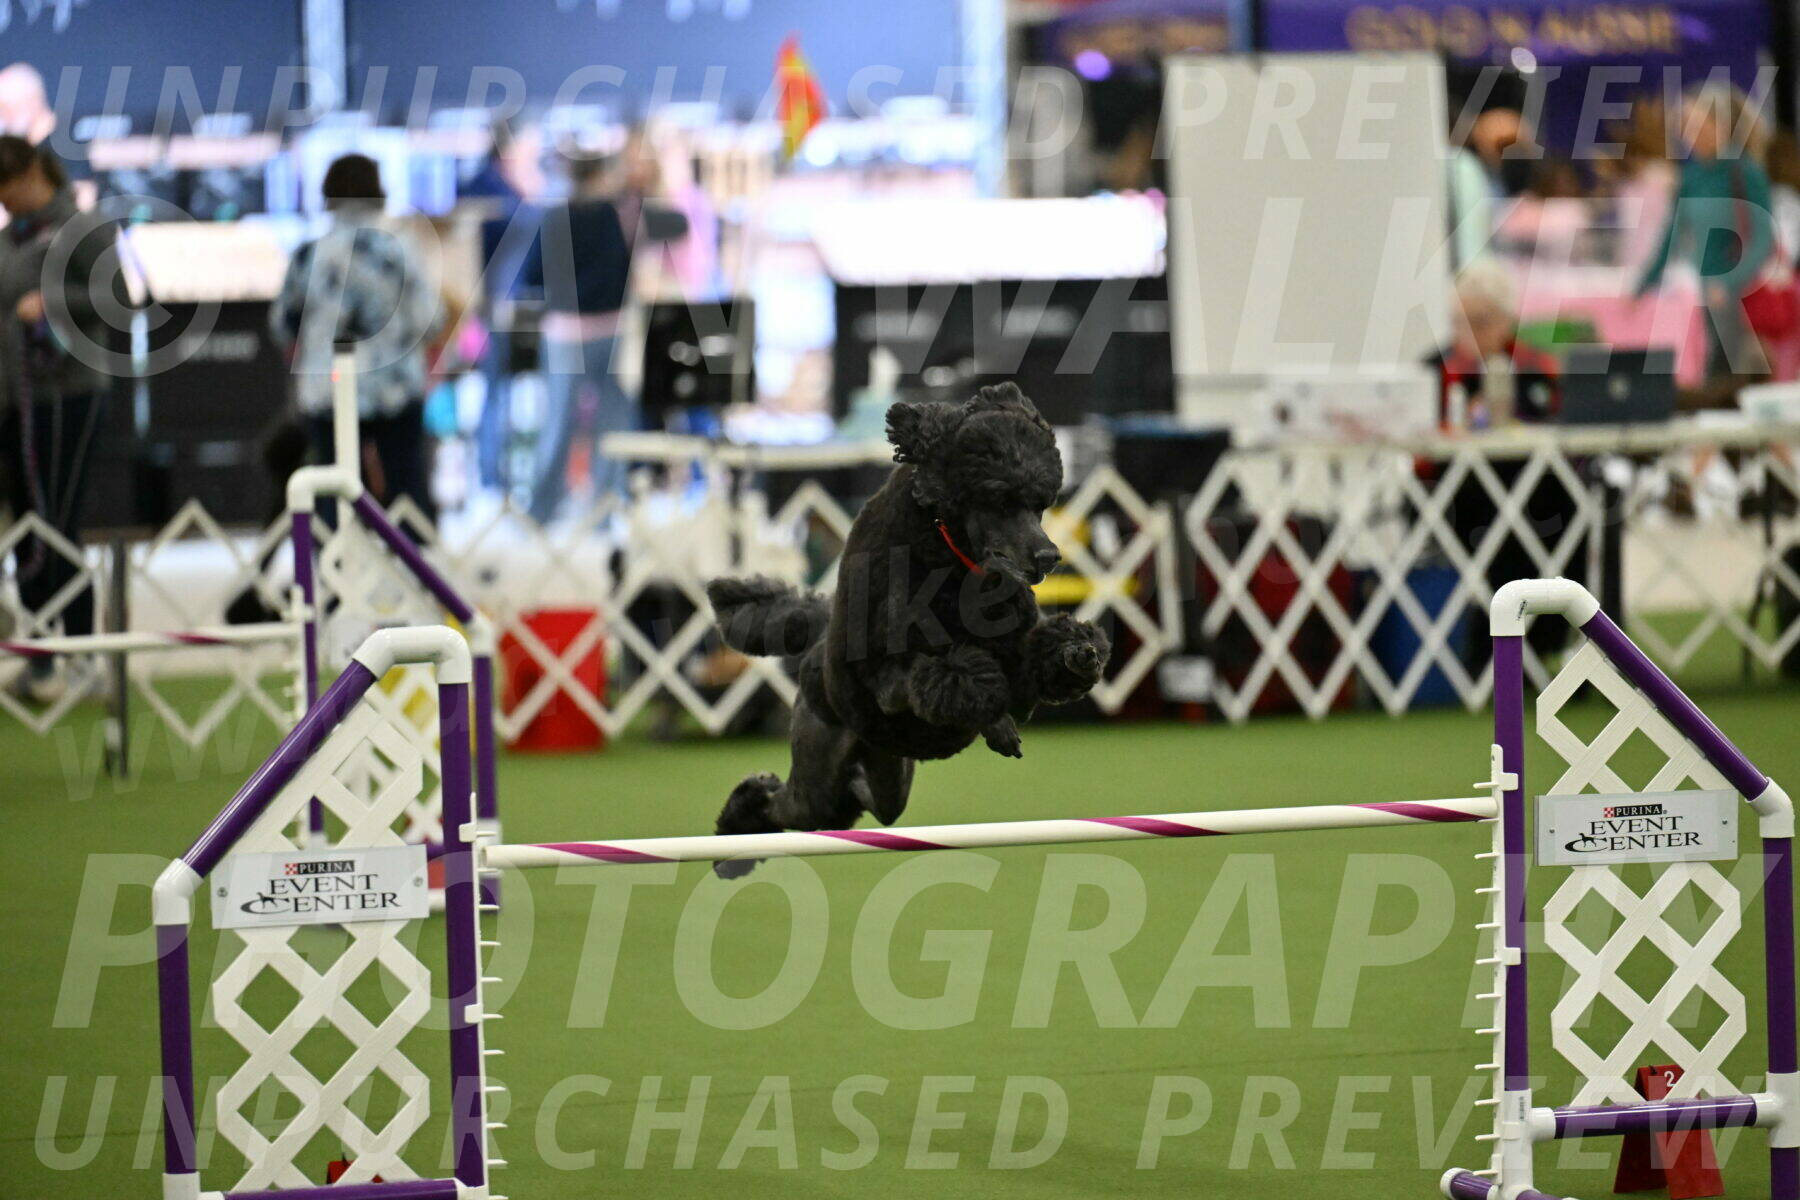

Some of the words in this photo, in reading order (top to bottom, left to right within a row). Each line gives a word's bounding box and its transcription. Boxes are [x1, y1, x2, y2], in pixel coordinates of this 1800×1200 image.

[1615, 805, 1662, 817] PURINA
[1589, 816, 1683, 835] EVENT
[1564, 832, 1703, 852] CENTER
[299, 860, 353, 874] PURINA
[269, 874, 378, 895] EVENT
[240, 892, 402, 914] CENTER
[1663, 1070, 1677, 1087] 2
